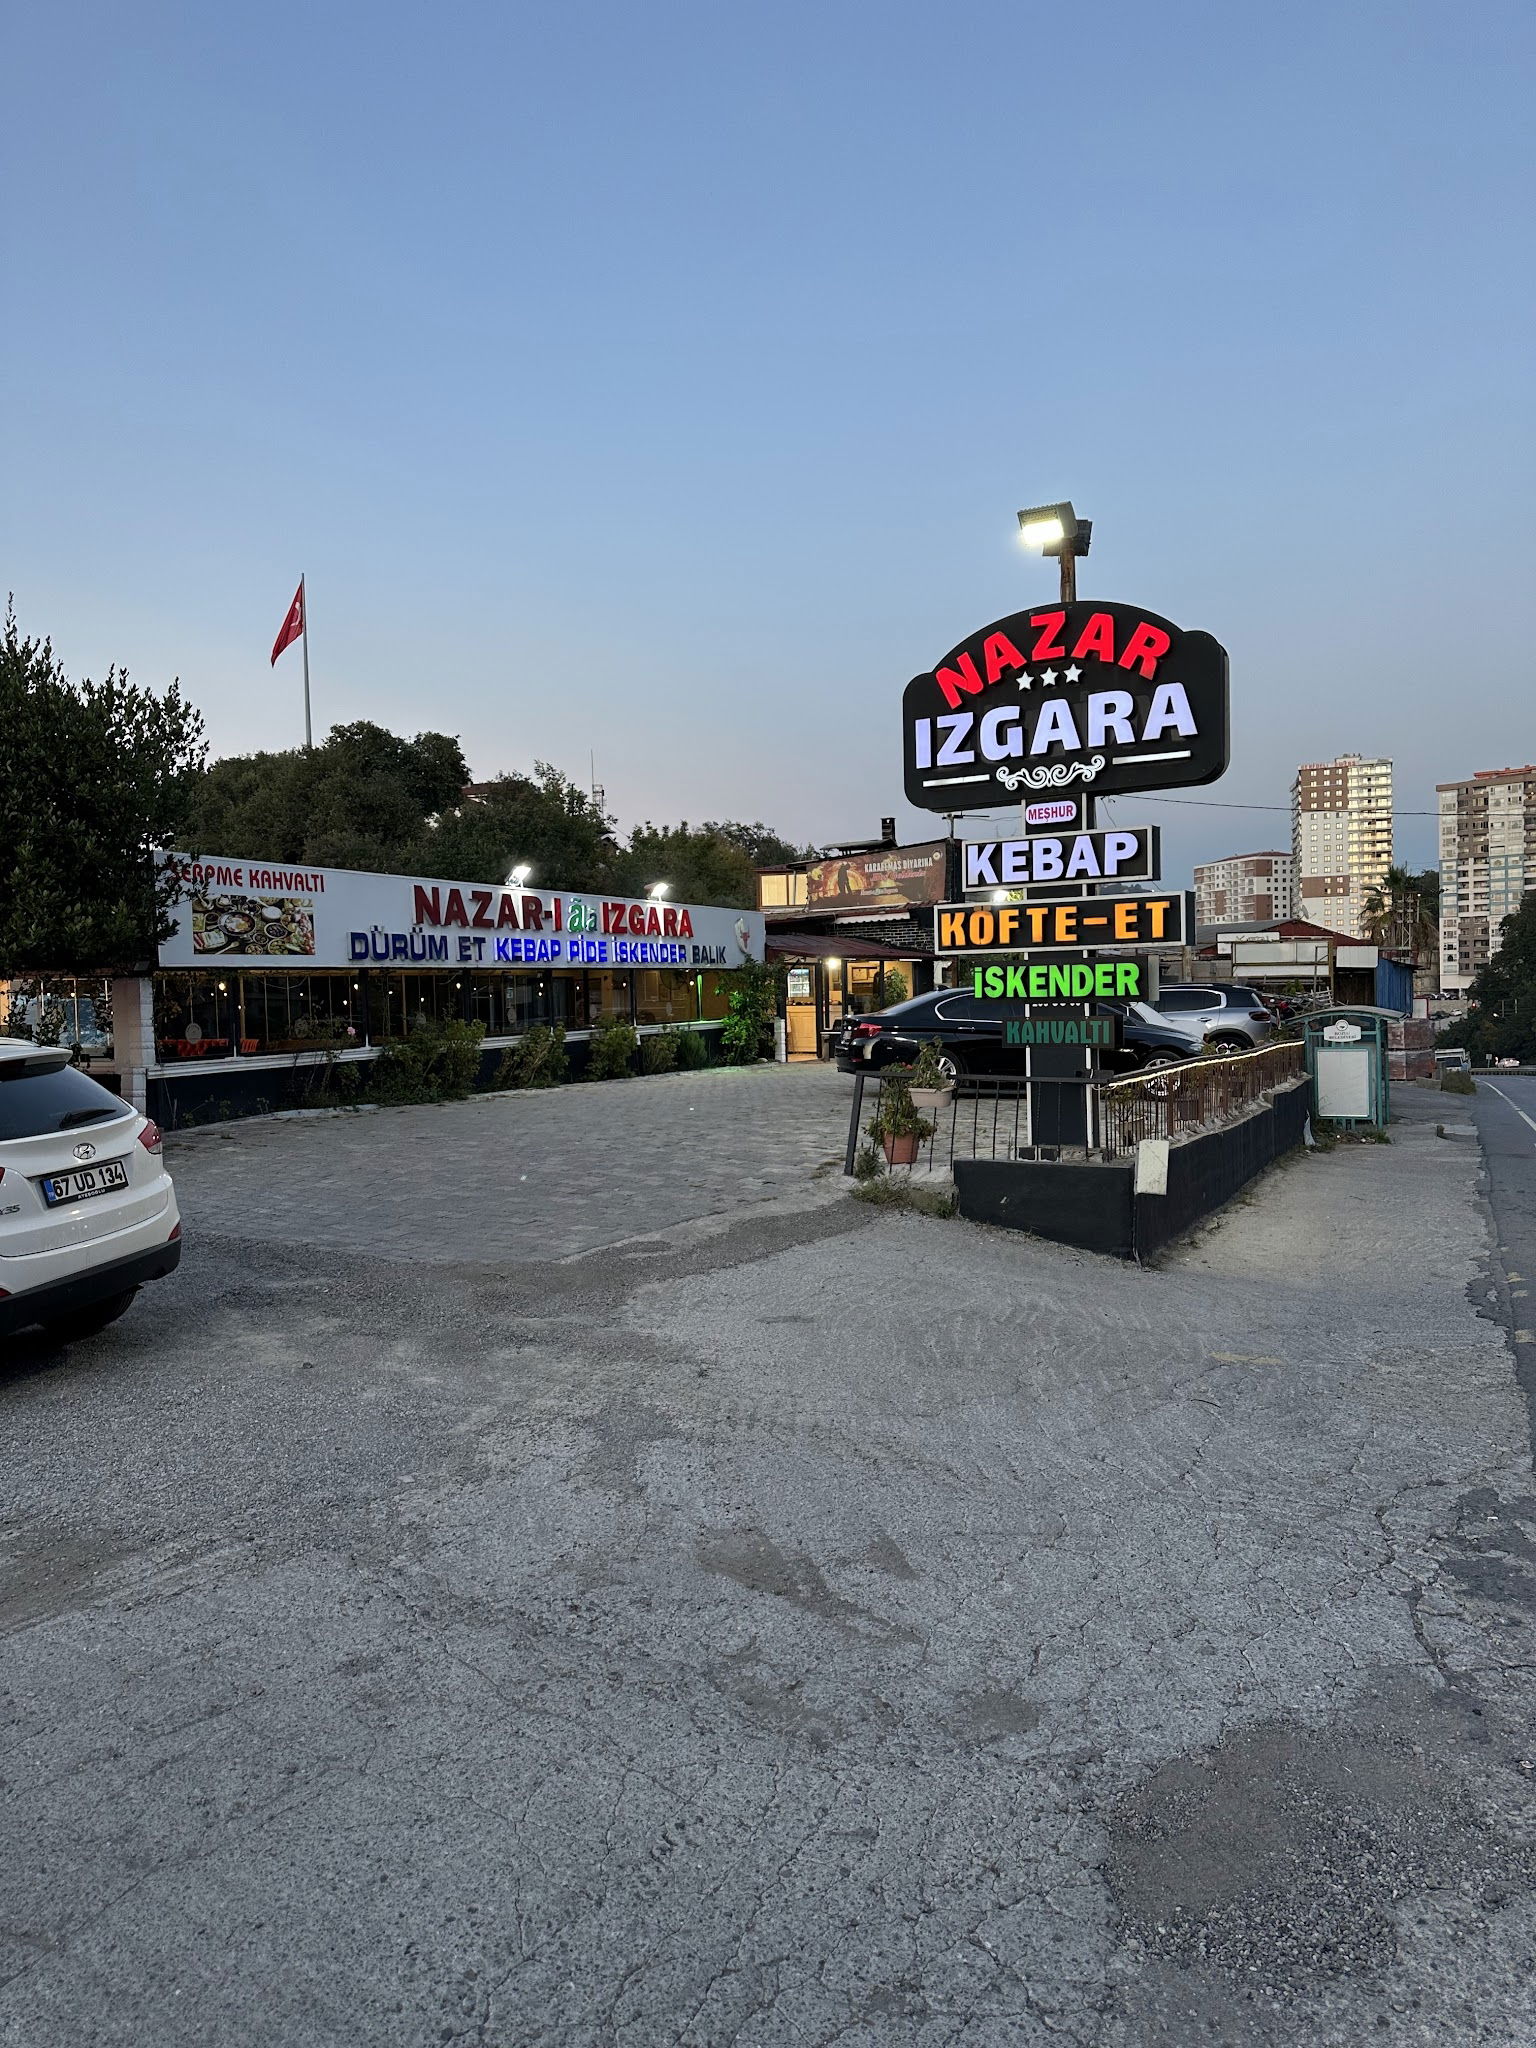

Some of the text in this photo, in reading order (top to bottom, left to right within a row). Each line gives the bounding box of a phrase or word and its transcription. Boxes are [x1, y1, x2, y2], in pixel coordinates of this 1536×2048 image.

[935, 611, 1171, 710] NAZAR
[914, 682, 1199, 769] IZGARA
[1027, 805, 1074, 822] MEŞHUR
[966, 832, 1139, 886] KEBAP
[249, 869, 325, 893] KAHVALTI
[413, 885, 562, 931] NAZAR-I
[601, 902, 694, 937] IZGARA
[348, 926, 726, 963] DÜRÜM ET KEBAP PİDE İSKENDER BALIK
[973, 962, 1140, 999] İSKENDER
[1006, 1019, 1110, 1044] KAHVALTI
[53, 1165, 122, 1197] 67 UD 134
